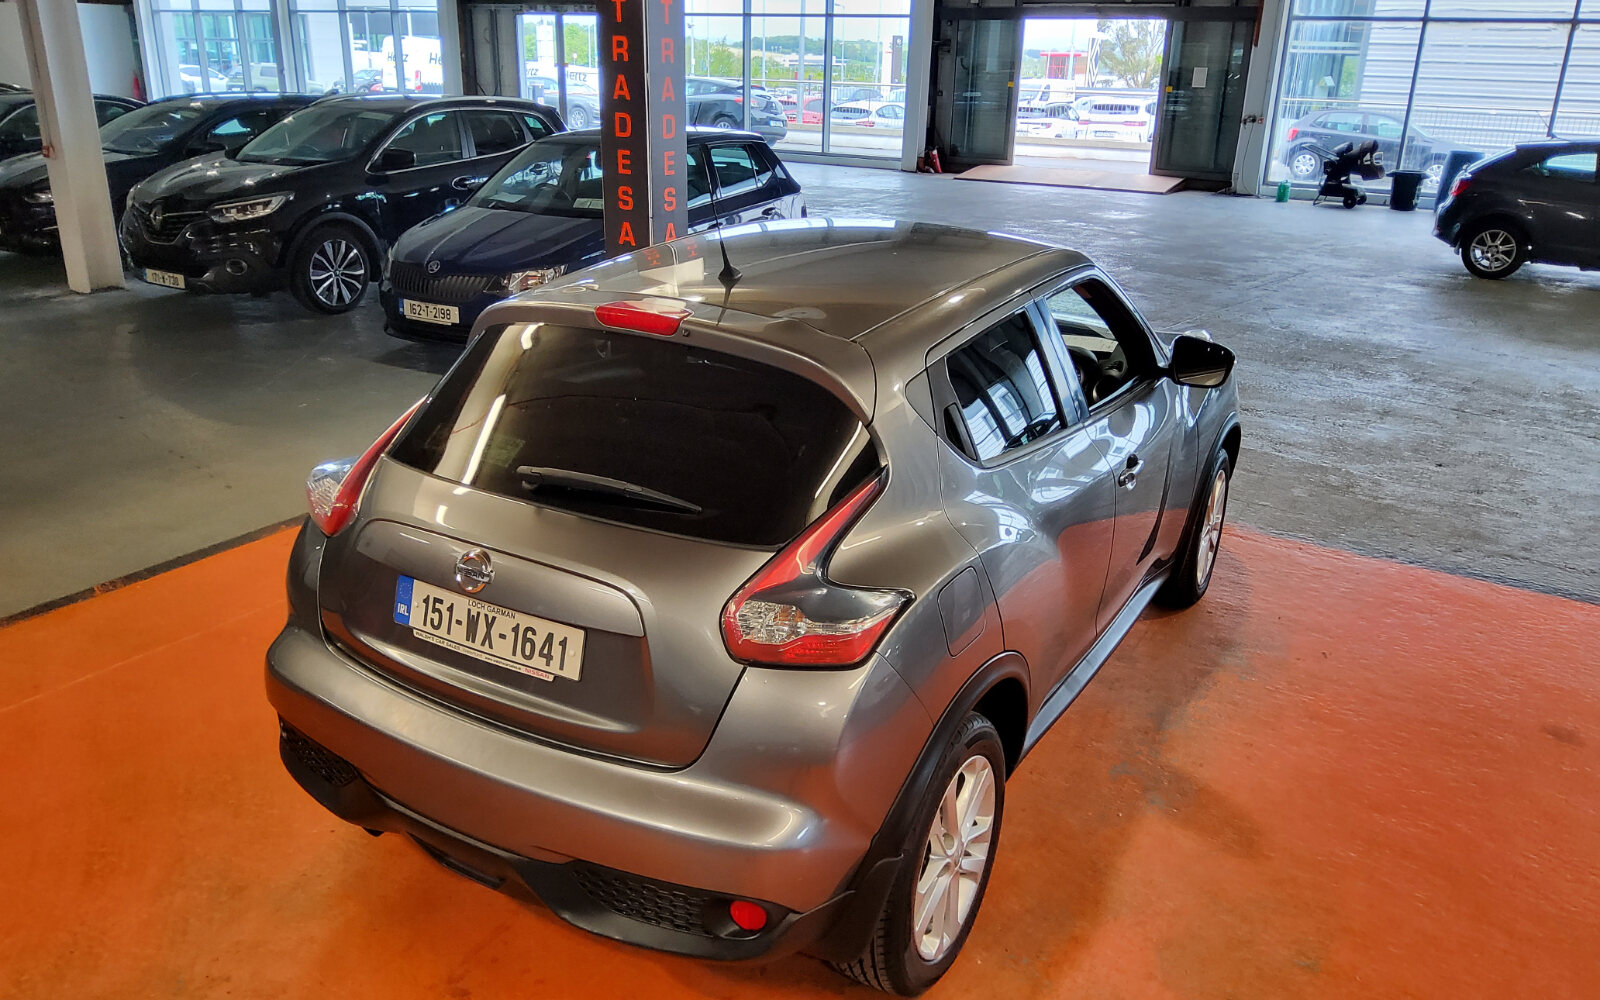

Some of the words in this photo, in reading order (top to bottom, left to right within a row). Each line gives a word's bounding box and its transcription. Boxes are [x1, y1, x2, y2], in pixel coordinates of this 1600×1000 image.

[387, 51, 409, 63] Hez
[409, 302, 452, 320] 162-T-2198
[397, 602, 409, 616] IRL
[468, 599, 486, 611] LOCH
[486, 605, 516, 619] GARMAN
[422, 594, 568, 671] 151-WX-1641
[524, 667, 550, 679] NISSAN
